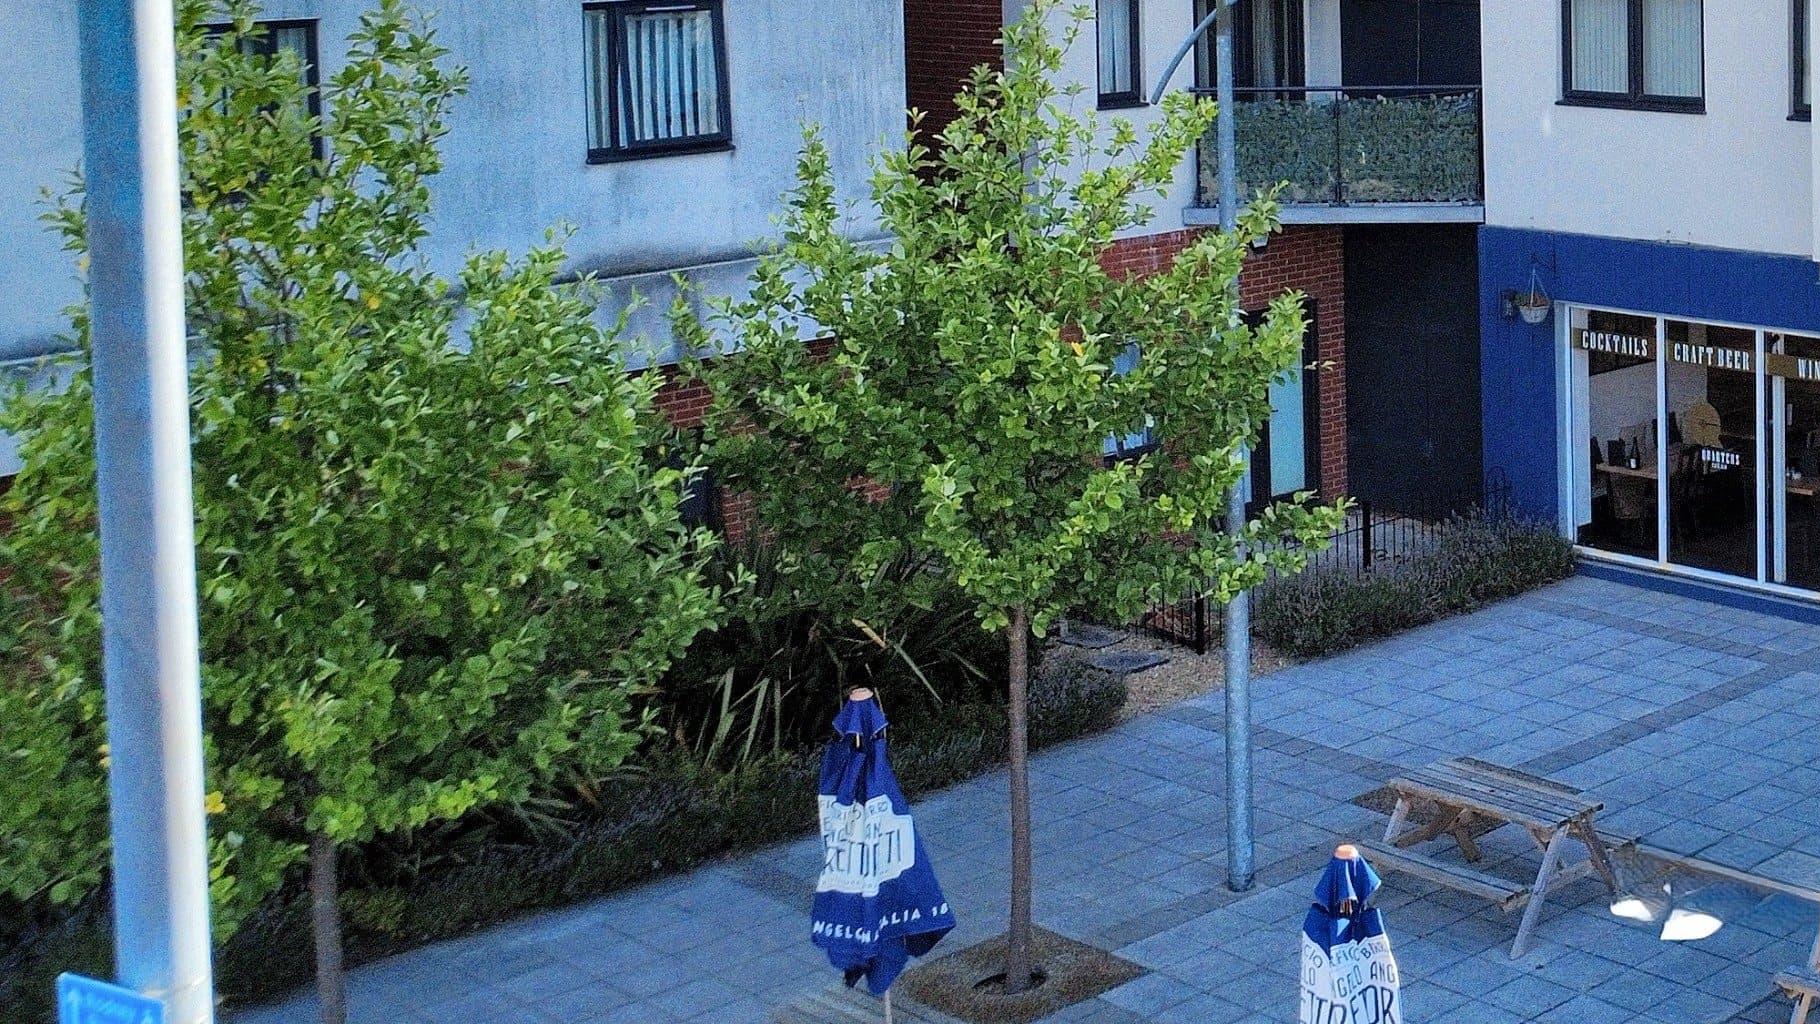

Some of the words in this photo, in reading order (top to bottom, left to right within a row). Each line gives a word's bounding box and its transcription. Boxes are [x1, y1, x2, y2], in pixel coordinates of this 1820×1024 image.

[1582, 330, 1648, 358] COCKTAILS
[1674, 342, 1713, 366] CRAFT
[1717, 348, 1750, 371] BEER
